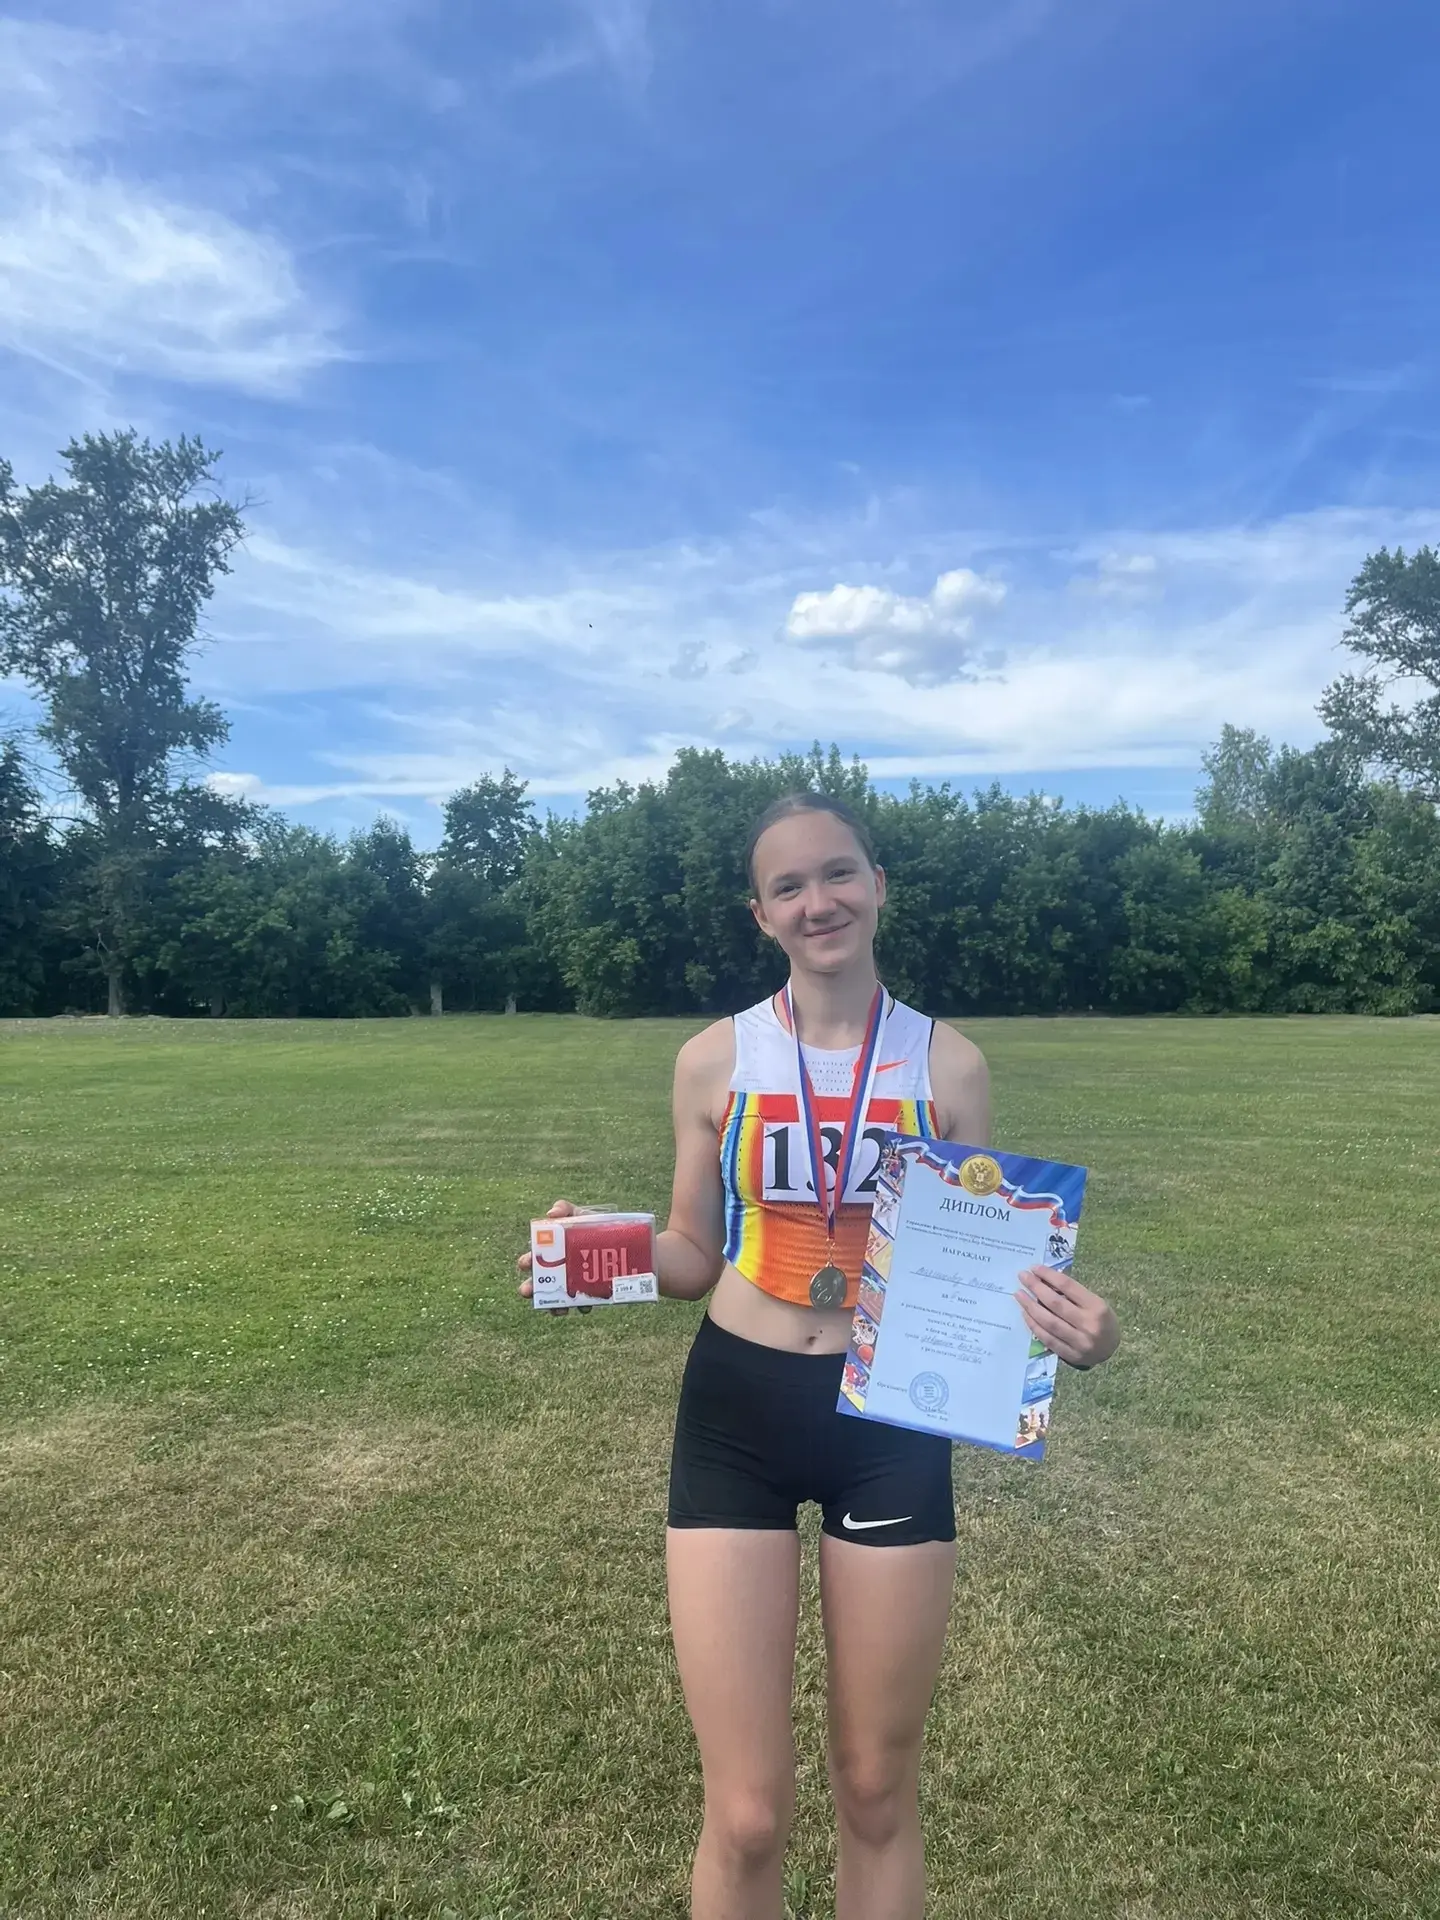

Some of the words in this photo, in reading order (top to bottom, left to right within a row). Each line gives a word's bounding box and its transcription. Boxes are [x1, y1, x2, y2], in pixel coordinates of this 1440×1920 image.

[939, 1197, 1011, 1221] ДИПЛОМ
[942, 1247, 991, 1262] НАГРАЖДАЕТ
[580, 1248, 638, 1284] JBL
[957, 1296, 977, 1305] место
